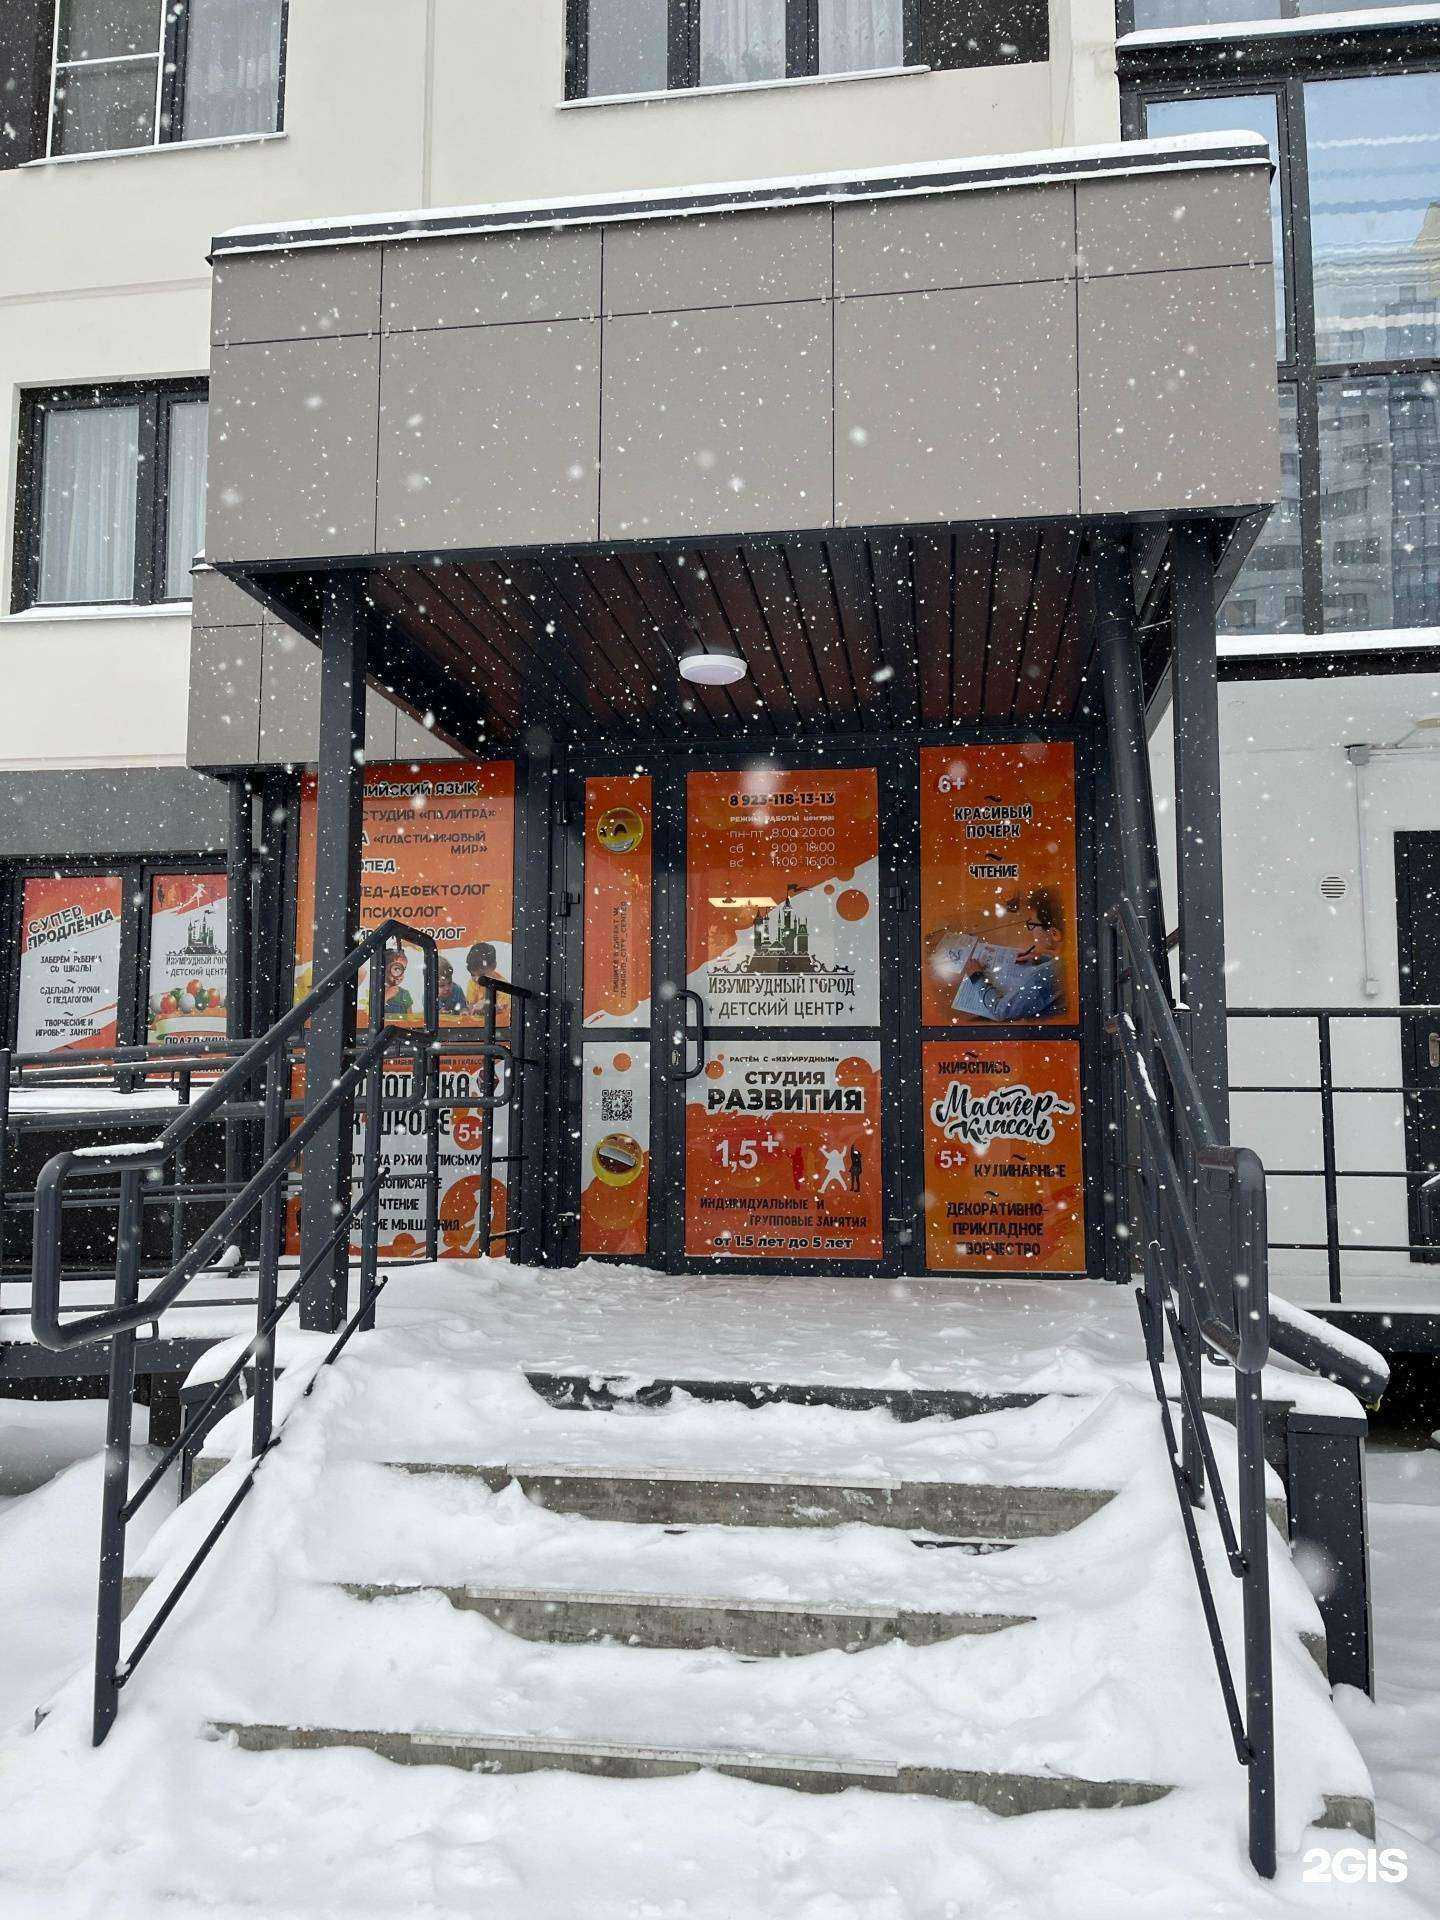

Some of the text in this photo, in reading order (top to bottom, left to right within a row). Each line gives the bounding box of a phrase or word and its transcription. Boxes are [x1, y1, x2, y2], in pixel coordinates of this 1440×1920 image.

[436, 782, 477, 794] ЯЗЫК
[938, 774, 966, 793] 6+
[954, 803, 1033, 821] КРАСИВЫЙ
[966, 824, 1021, 839] ПОЧЕРК
[450, 844, 487, 855] МИР»
[969, 864, 1019, 879] ЧТЕНИЕ
[28, 905, 82, 934] СУПЕР
[363, 906, 443, 918] ПСИХОЛОГ
[170, 967, 203, 978] ДЕТСКИЙ
[708, 976, 856, 997] ИЗУМРУДНЫЙ ГОРОД
[718, 998, 845, 1019] ДЕТСКИЙ ЦЕНТР
[45, 1019, 87, 1027] ТВОРЧЕСКИЕ
[938, 1061, 1011, 1074] ЖИВОПИСЬ
[745, 1071, 825, 1087] СТУДИЯ
[707, 1088, 863, 1112] РАЗВИТИЯ
[458, 1123, 483, 1142] 5+
[394, 1154, 423, 1165] РУКИ
[940, 1151, 966, 1168] 5+
[974, 1164, 1066, 1178] КУЛИНАРНЫЕ
[380, 1199, 420, 1211] ЧТЕНИЕ
[947, 1202, 1048, 1218] ДЕКОРАТИВНО-
[749, 1215, 867, 1228] ГРУППОВЫЕ ЗАНЯТИЯ
[953, 1222, 1043, 1238] ПРИКЛАДНОЕ
[713, 1235, 853, 1249] от 1.5 лет до 5 лет
